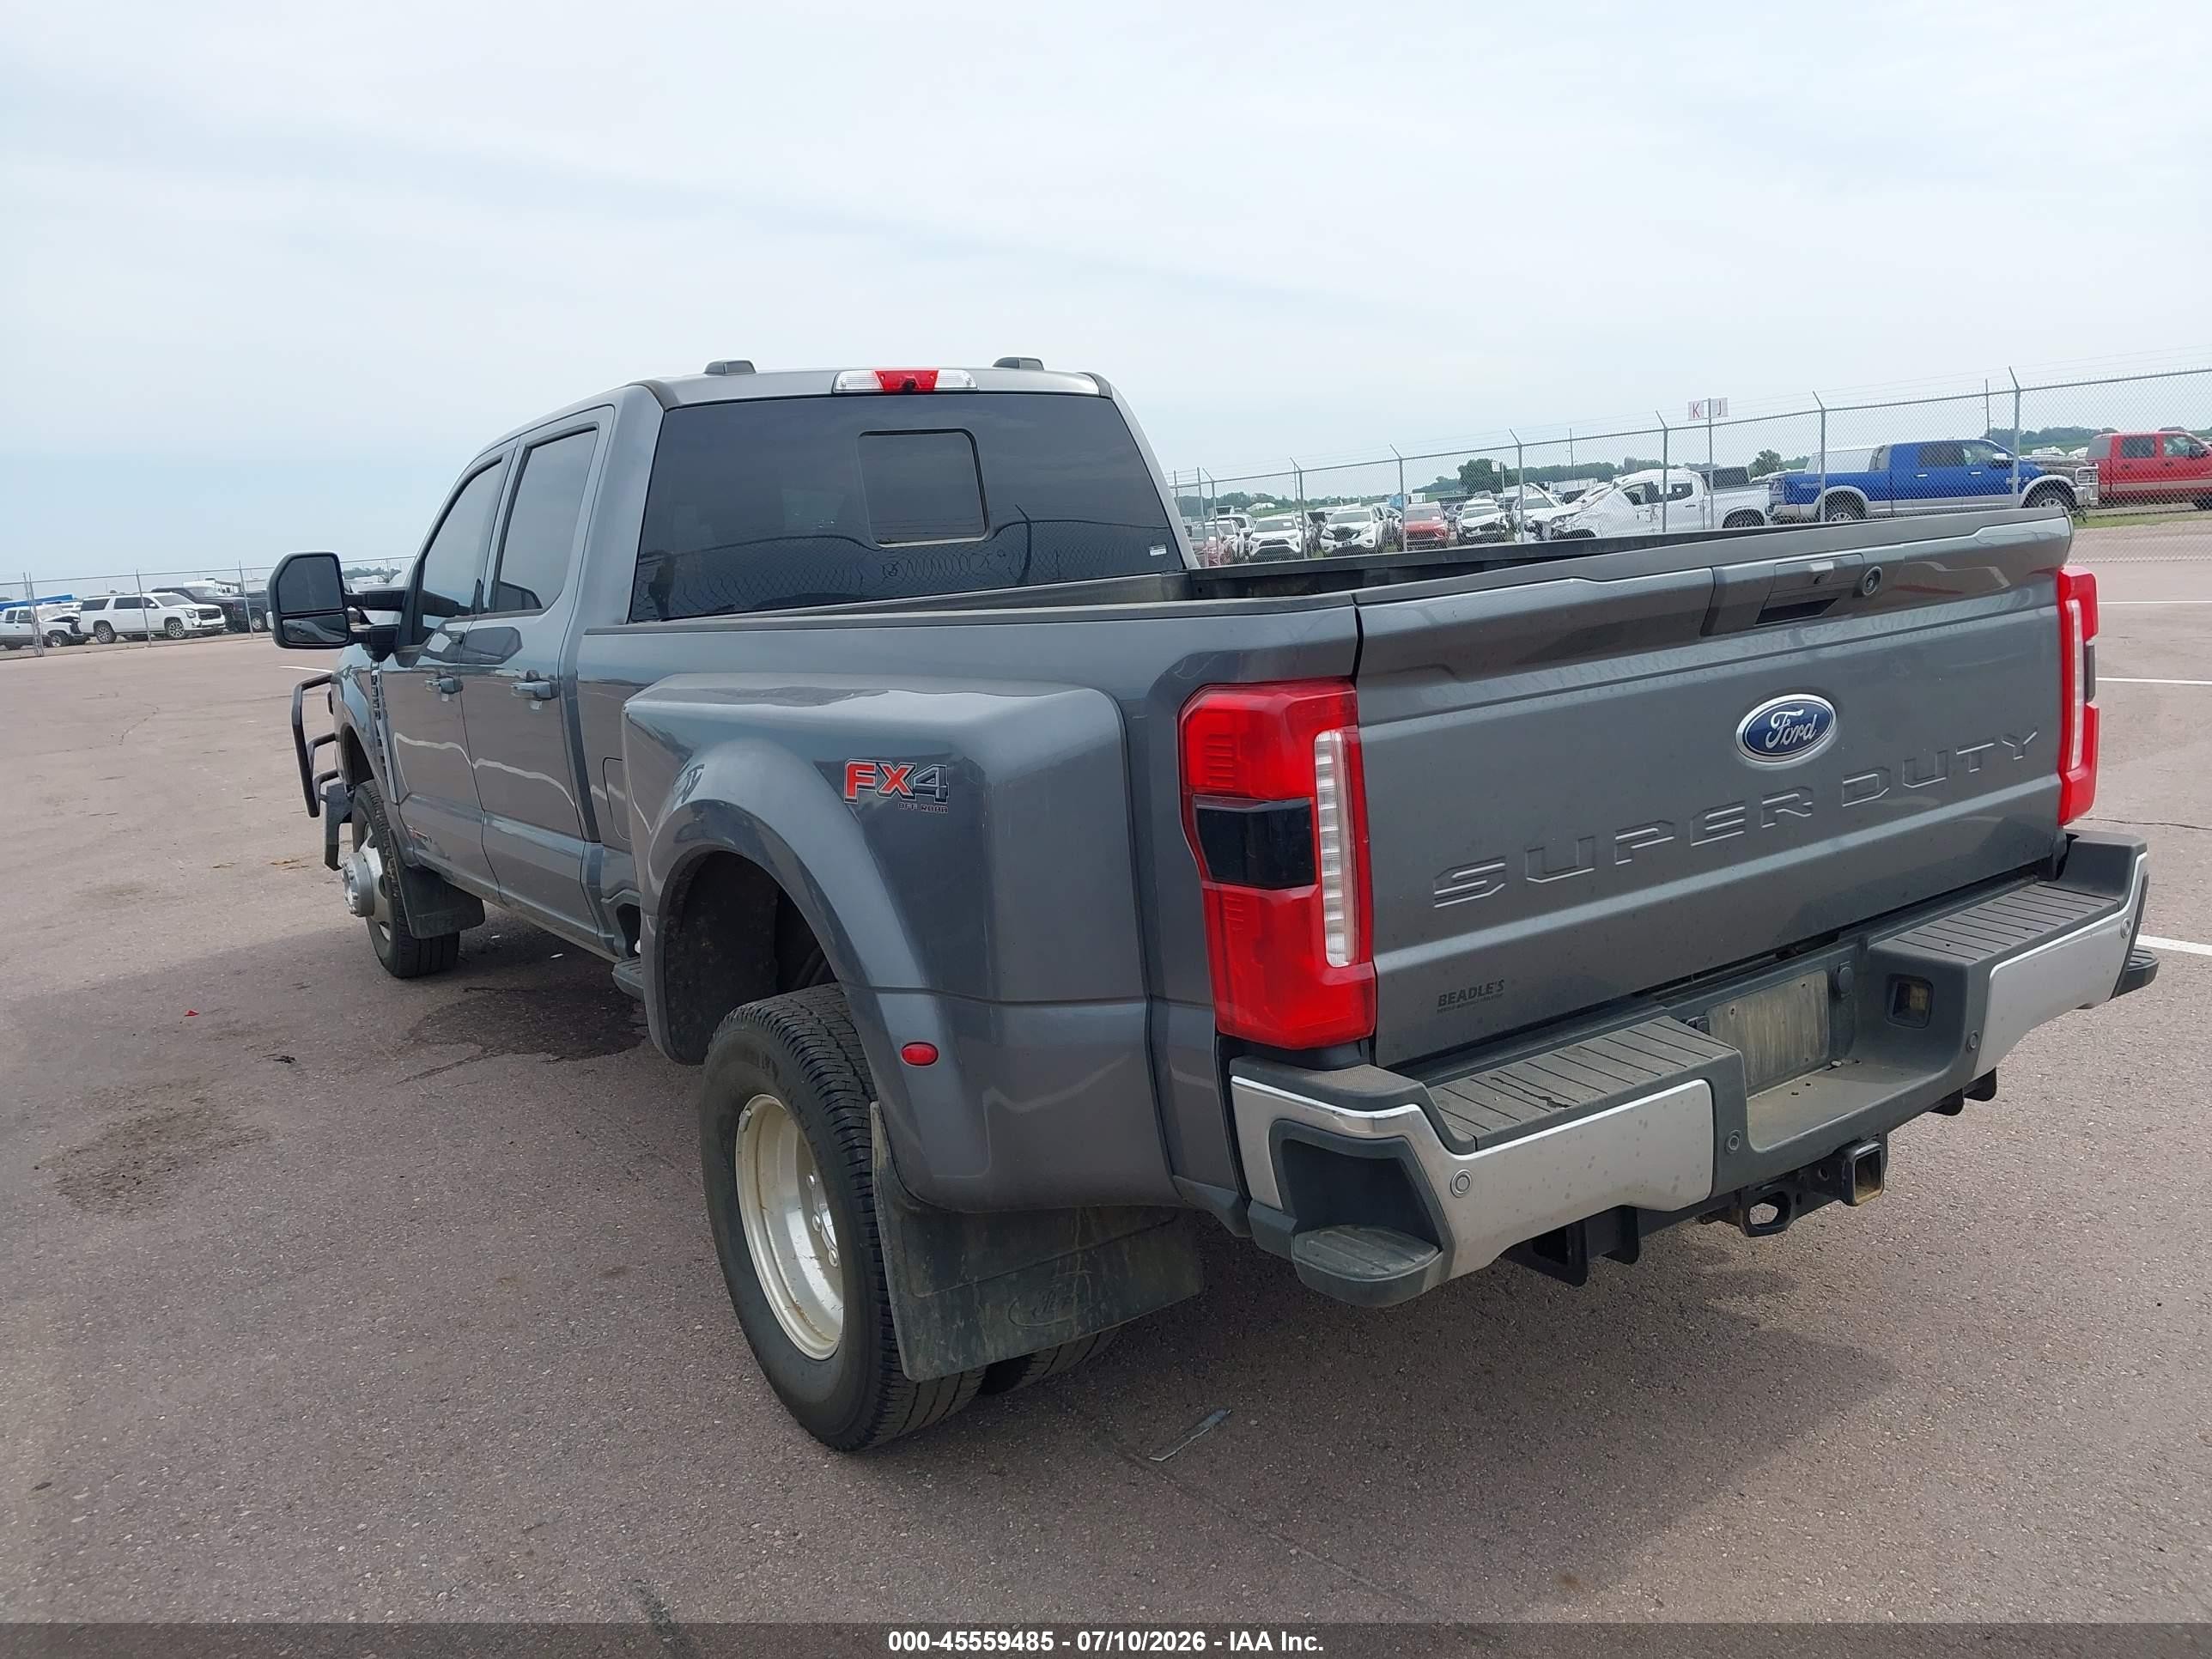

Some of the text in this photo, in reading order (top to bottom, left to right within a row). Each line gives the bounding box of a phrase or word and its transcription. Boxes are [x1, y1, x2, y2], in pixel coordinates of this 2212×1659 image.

[1692, 403, 1700, 419] K
[1717, 400, 1722, 416] J
[1765, 708, 1818, 750] Ford
[844, 758, 950, 805] FX4
[898, 802, 948, 814] OFF ROAD
[1433, 731, 2039, 908] SUPER DUTY
[1437, 979, 1504, 1007] BEADLE'S
